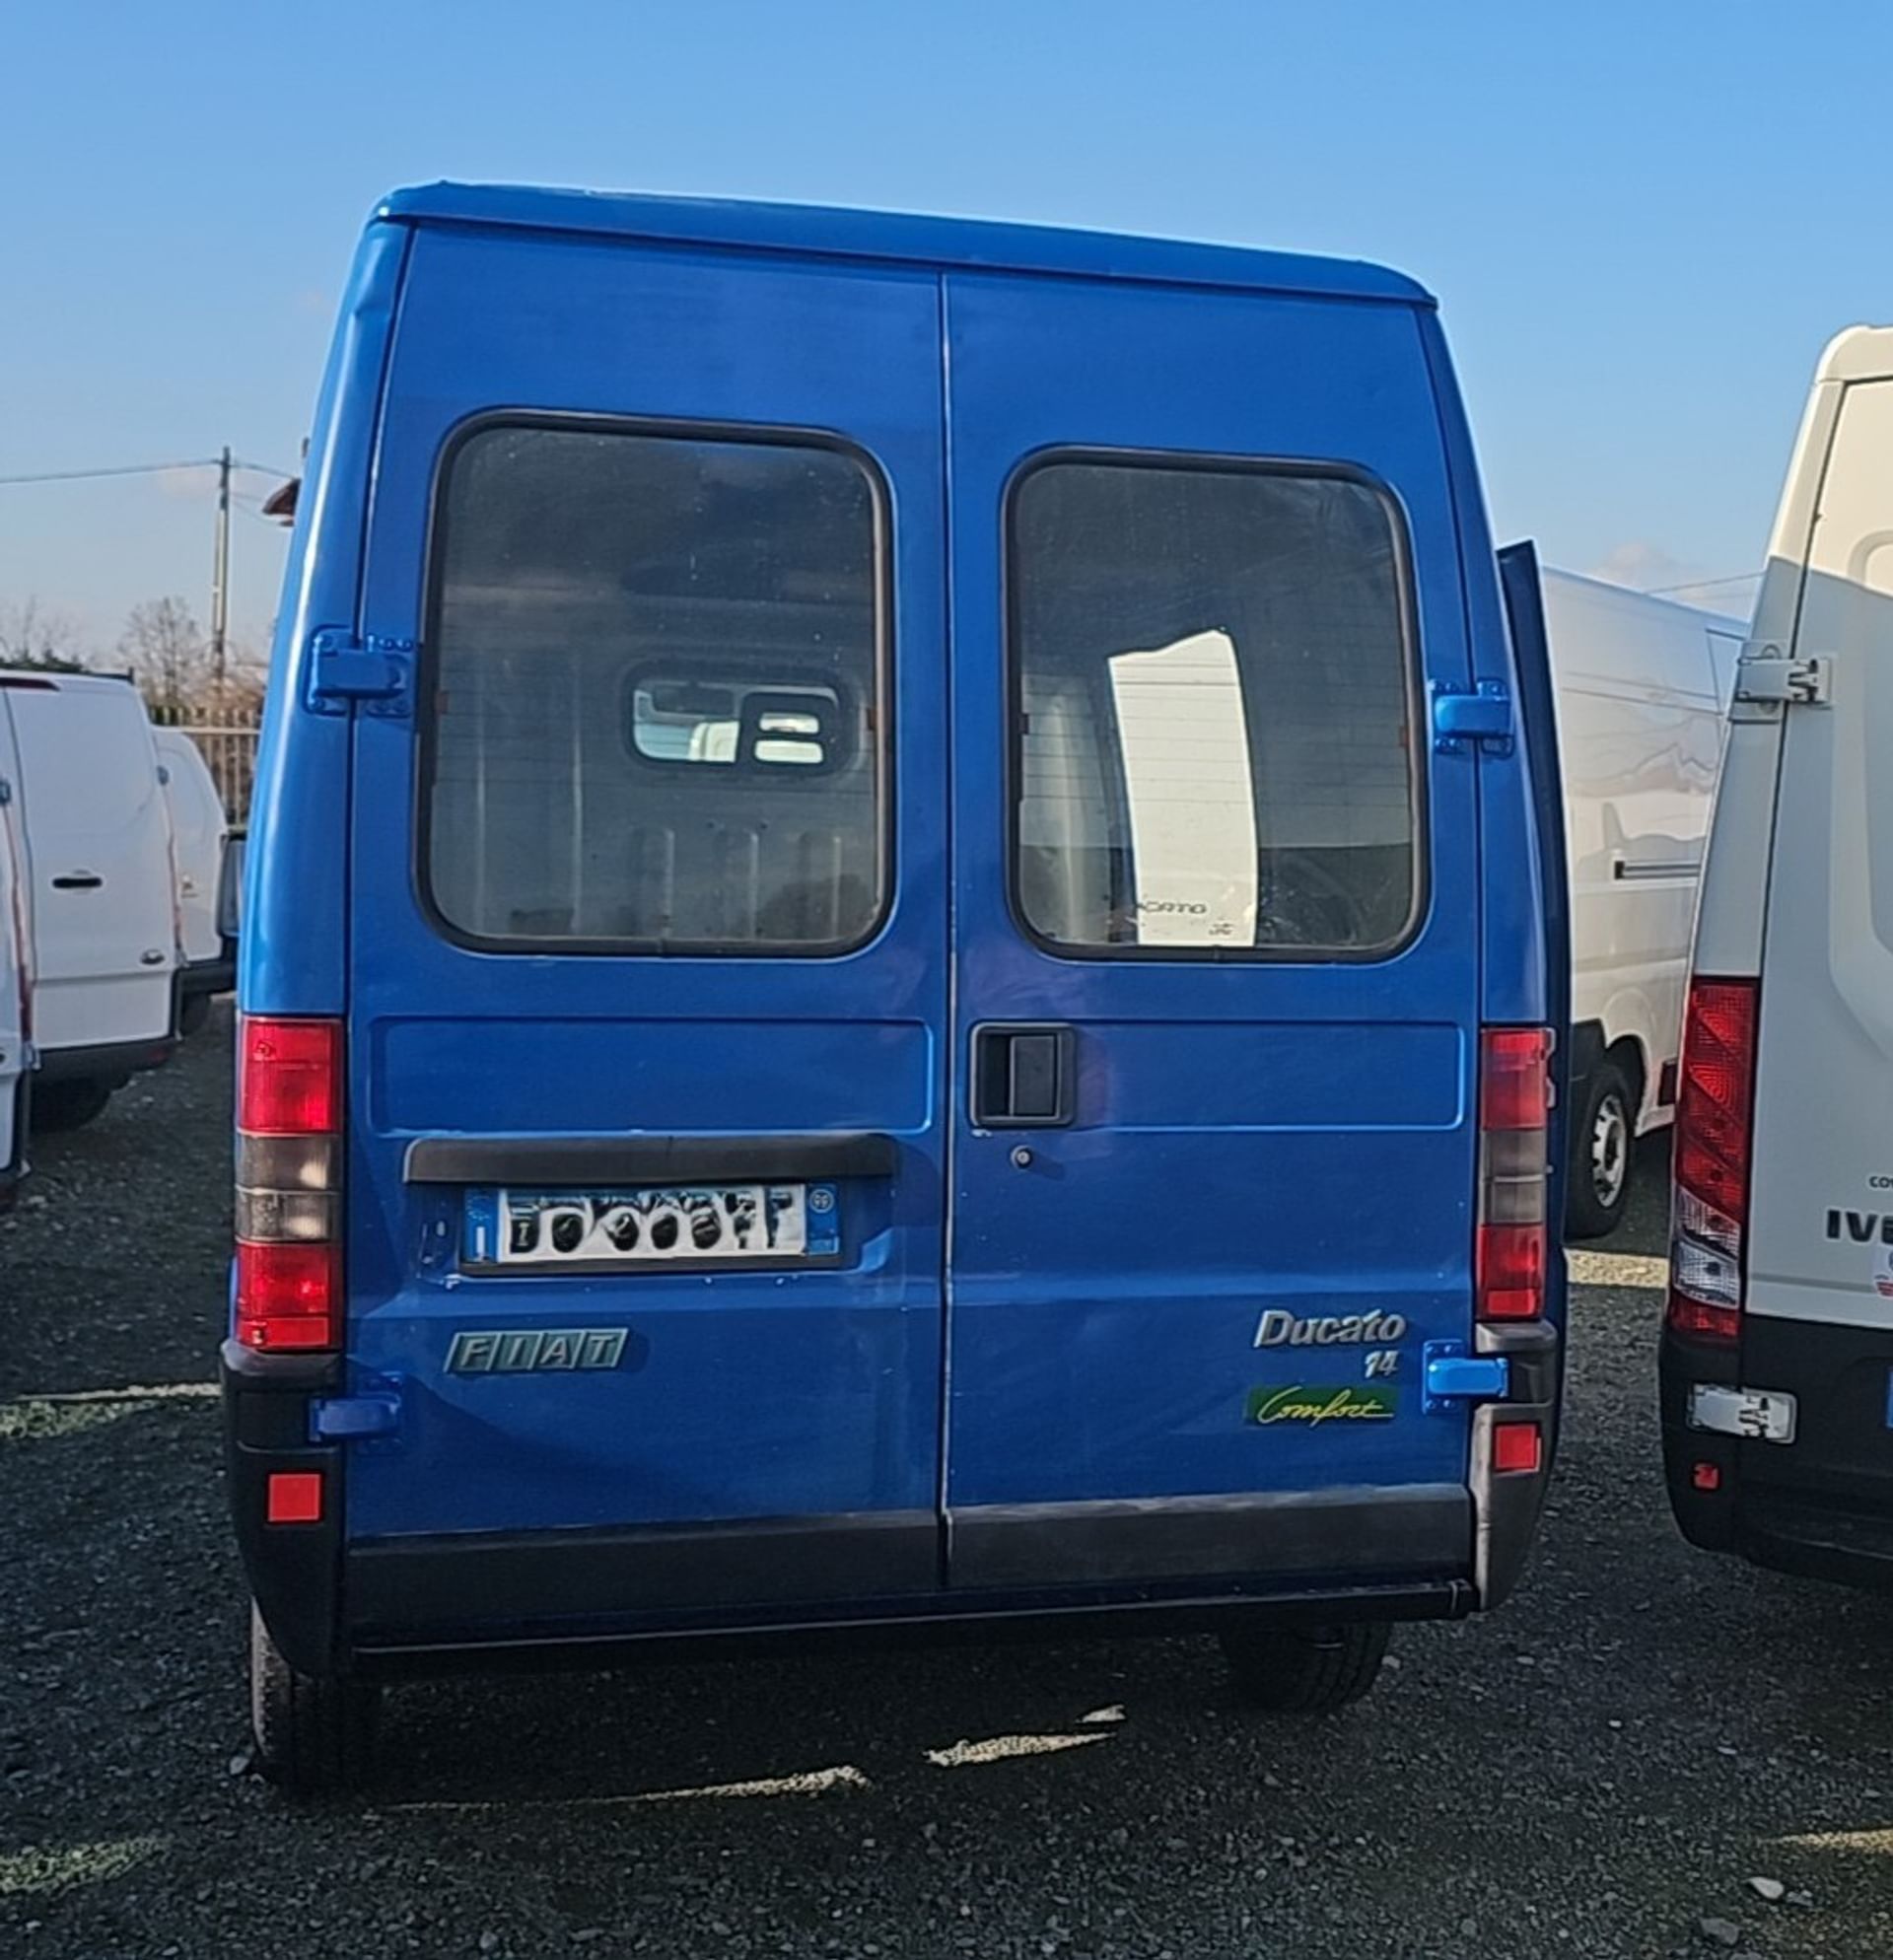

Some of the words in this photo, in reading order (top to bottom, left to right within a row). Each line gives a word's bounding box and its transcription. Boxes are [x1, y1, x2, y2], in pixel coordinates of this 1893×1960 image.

[1253, 1308, 1407, 1349] Ducato
[457, 1334, 618, 1368] FIAT
[1365, 1350, 1399, 1378] 14
[1257, 1386, 1395, 1428] Comfort
